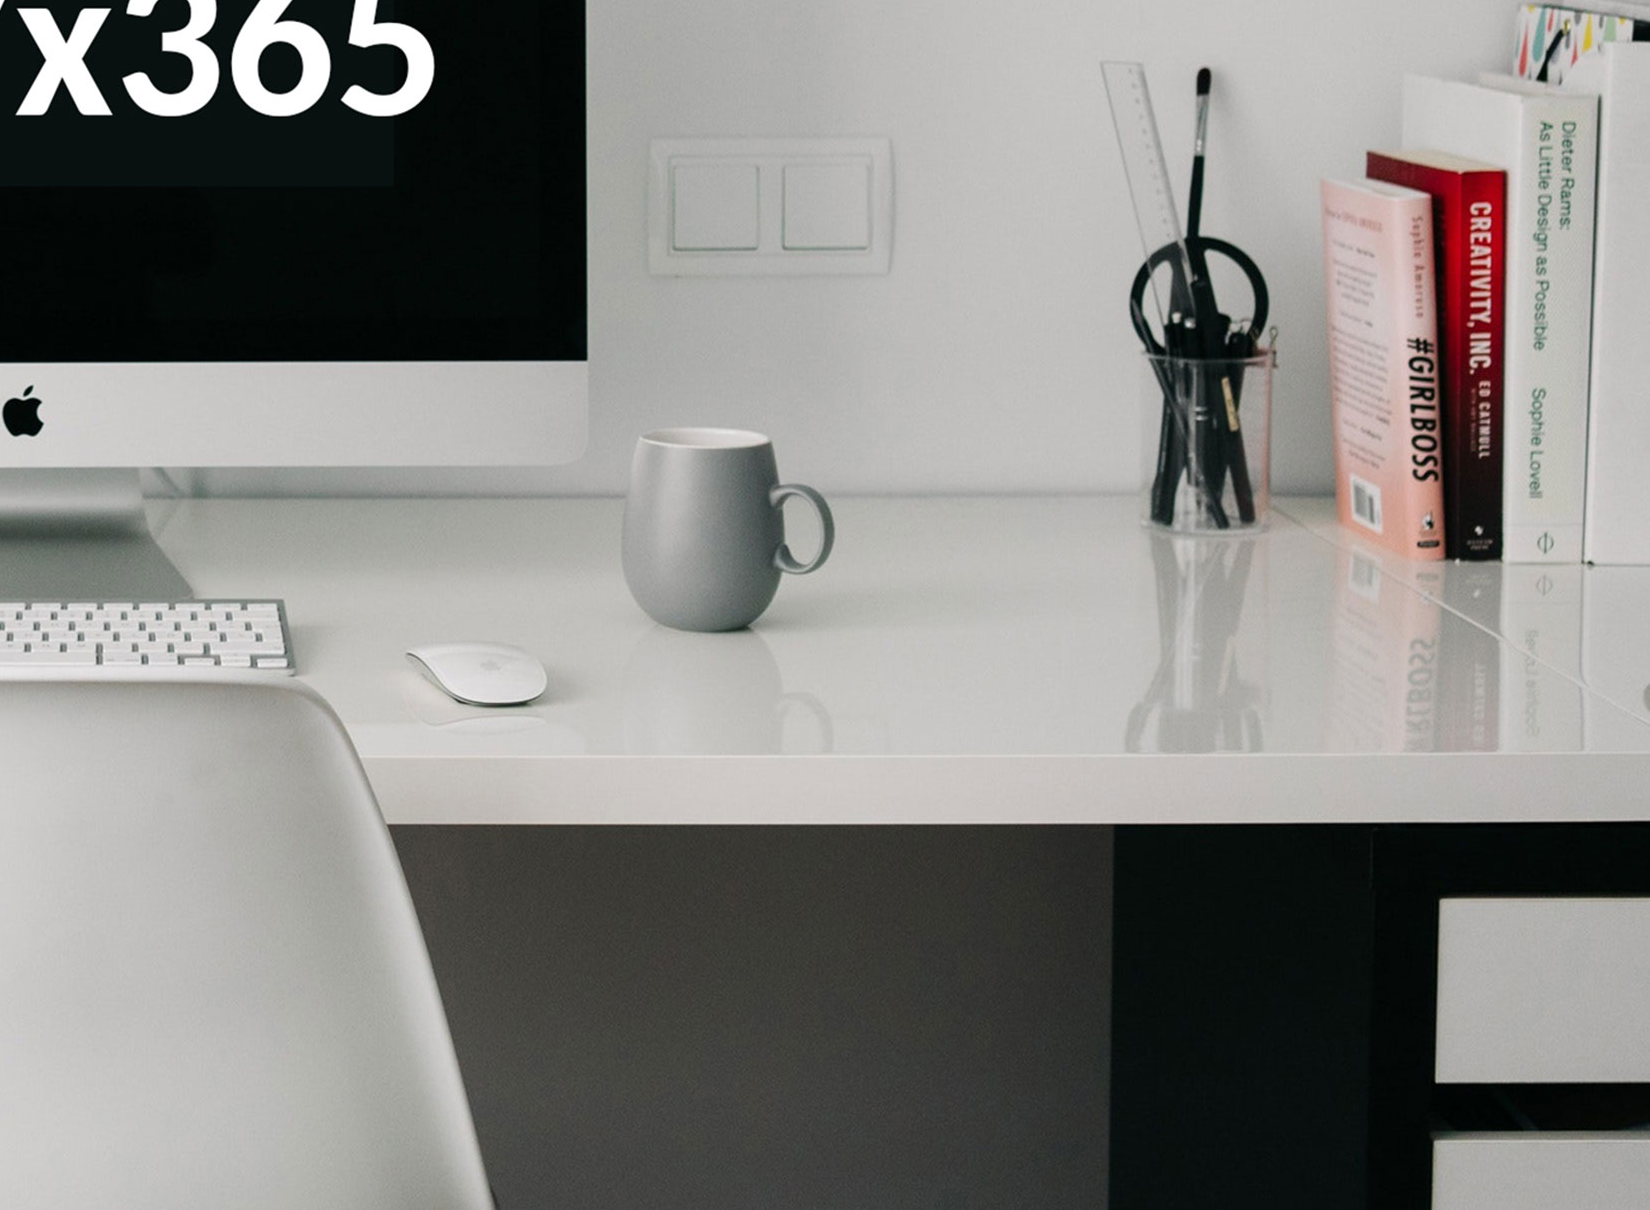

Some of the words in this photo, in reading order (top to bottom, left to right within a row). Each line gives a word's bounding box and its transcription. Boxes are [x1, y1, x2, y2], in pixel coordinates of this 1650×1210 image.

[1539, 121, 1553, 141] As
[1561, 121, 1577, 173] Dieter
[1538, 147, 1552, 190] Little
[1533, 195, 1552, 252] Design
[1559, 178, 1575, 230] Rams:
[1410, 216, 1423, 258] Sophie
[1467, 201, 1492, 328] CREATIVITY,
[1536, 256, 1547, 276] as
[1533, 280, 1550, 351] Possible
[1469, 332, 1491, 375] INC.
[1407, 337, 1439, 482] #GIRLBOSS
[1479, 380, 1491, 397] ED
[1479, 402, 1491, 459] CATMULL
[1529, 388, 1546, 446] Sophie
[1529, 451, 1543, 498] Lovell
